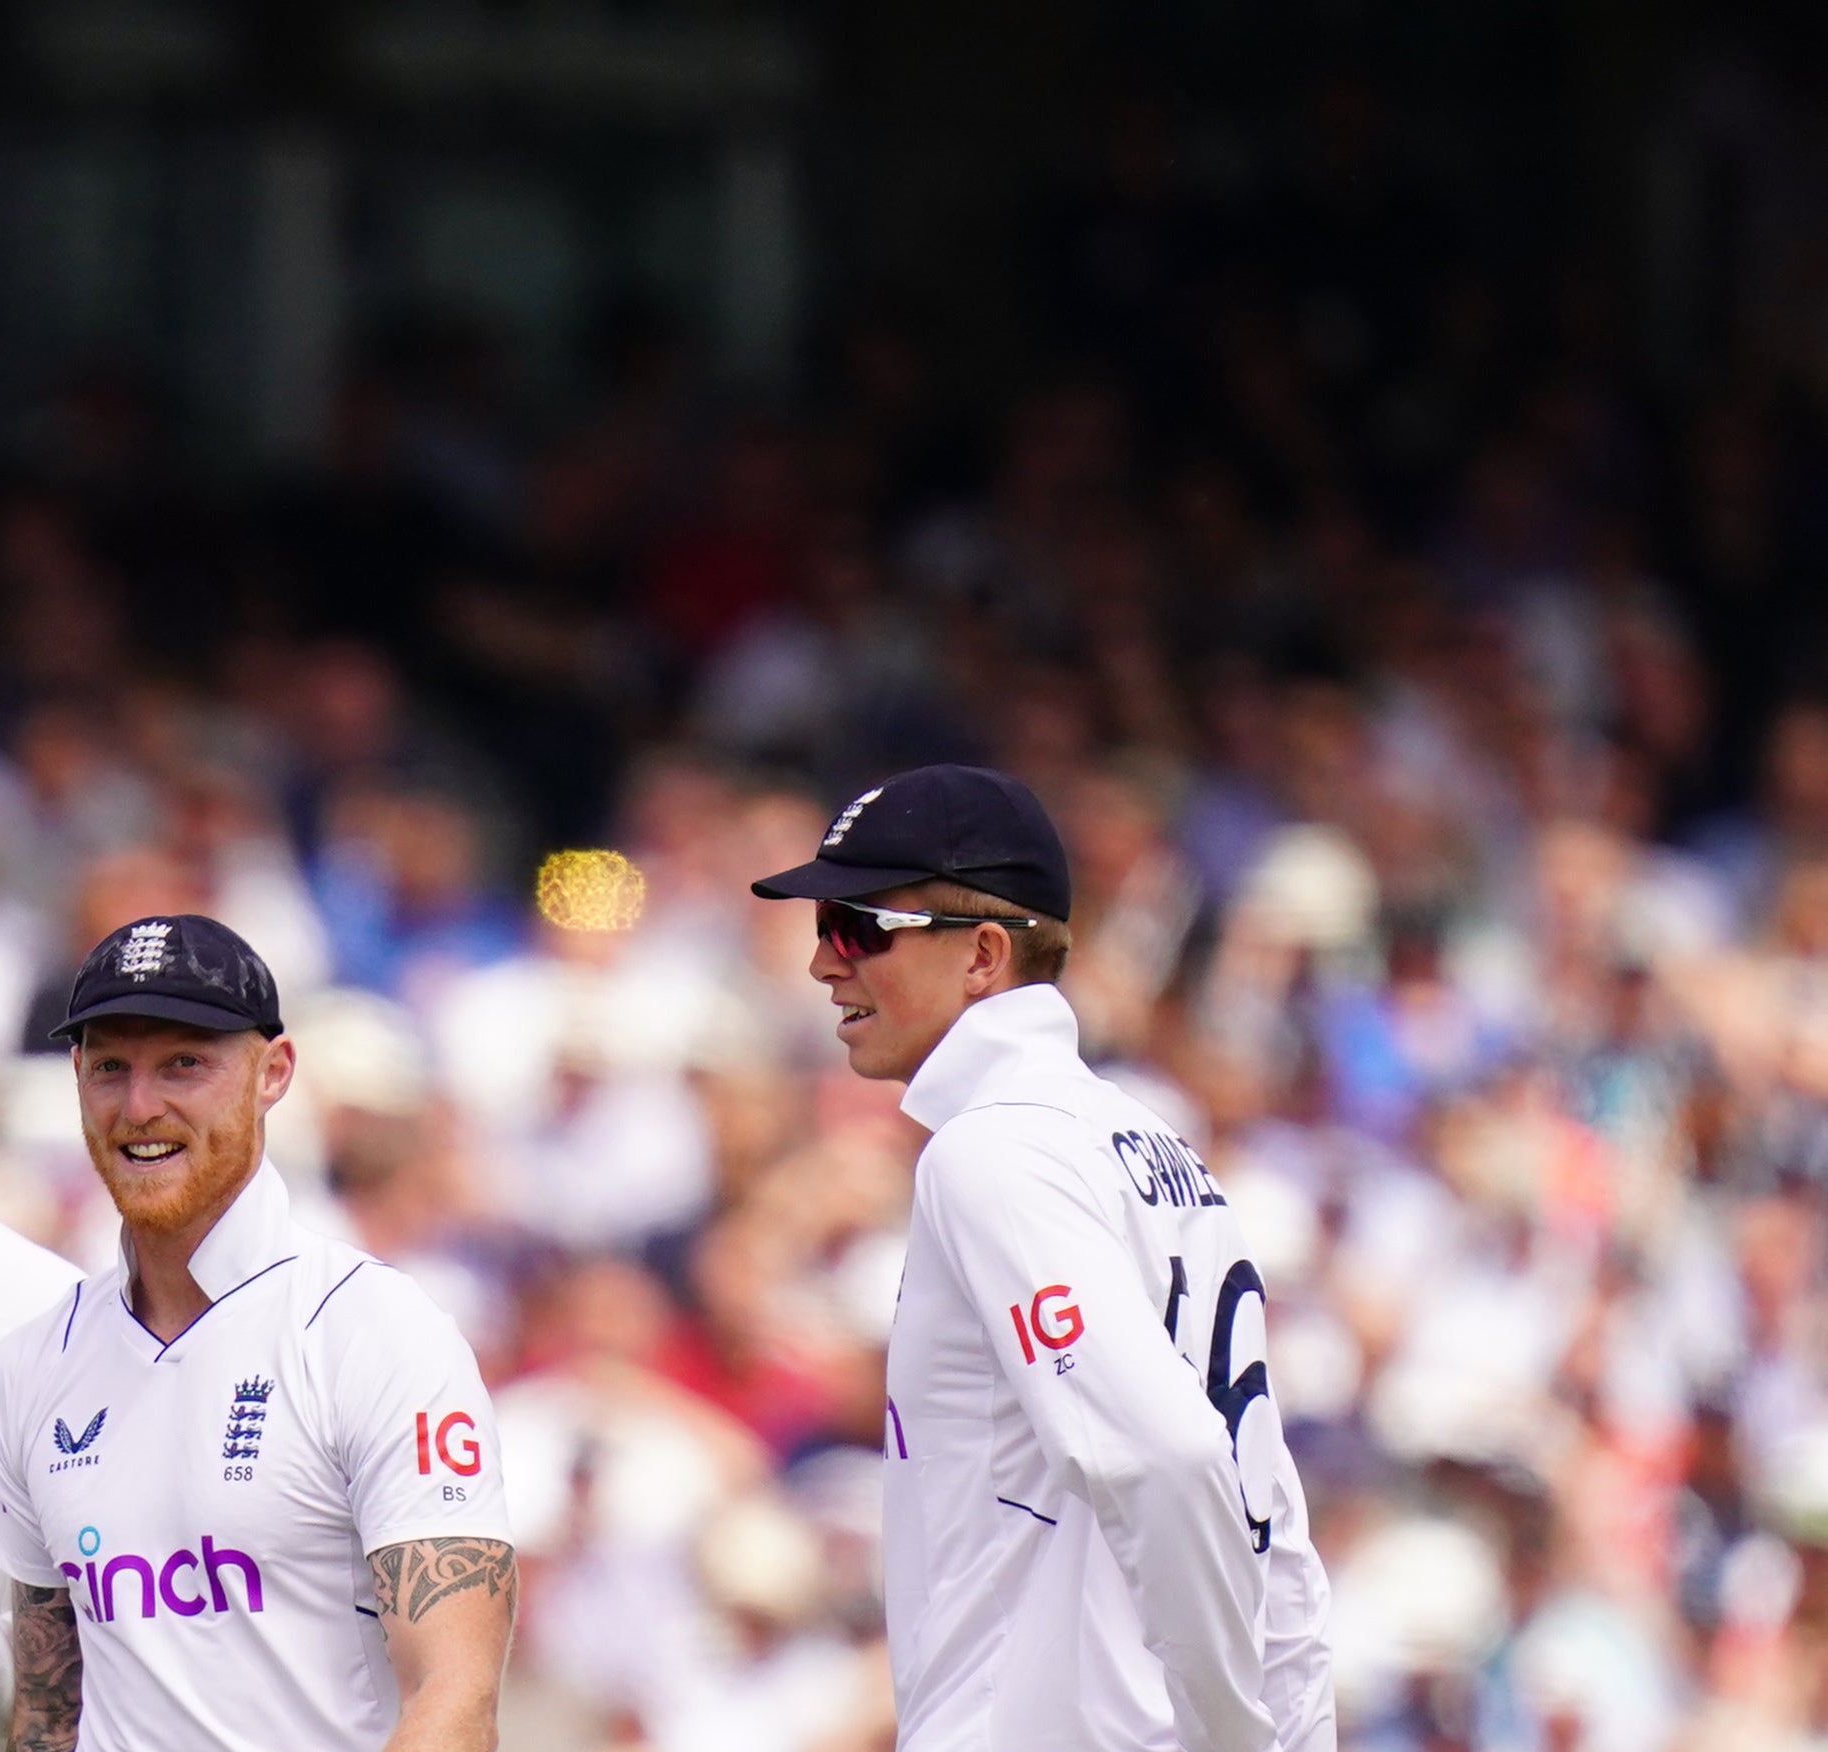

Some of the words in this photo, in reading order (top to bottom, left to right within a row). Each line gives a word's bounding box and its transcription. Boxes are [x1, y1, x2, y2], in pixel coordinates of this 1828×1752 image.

[1010, 1285, 1086, 1366] IG
[1053, 1353, 1076, 1376] ZC
[416, 1410, 482, 1478] IG
[49, 1455, 101, 1474] CASTORE
[224, 1465, 254, 1482] 658
[442, 1485, 467, 1502] BS
